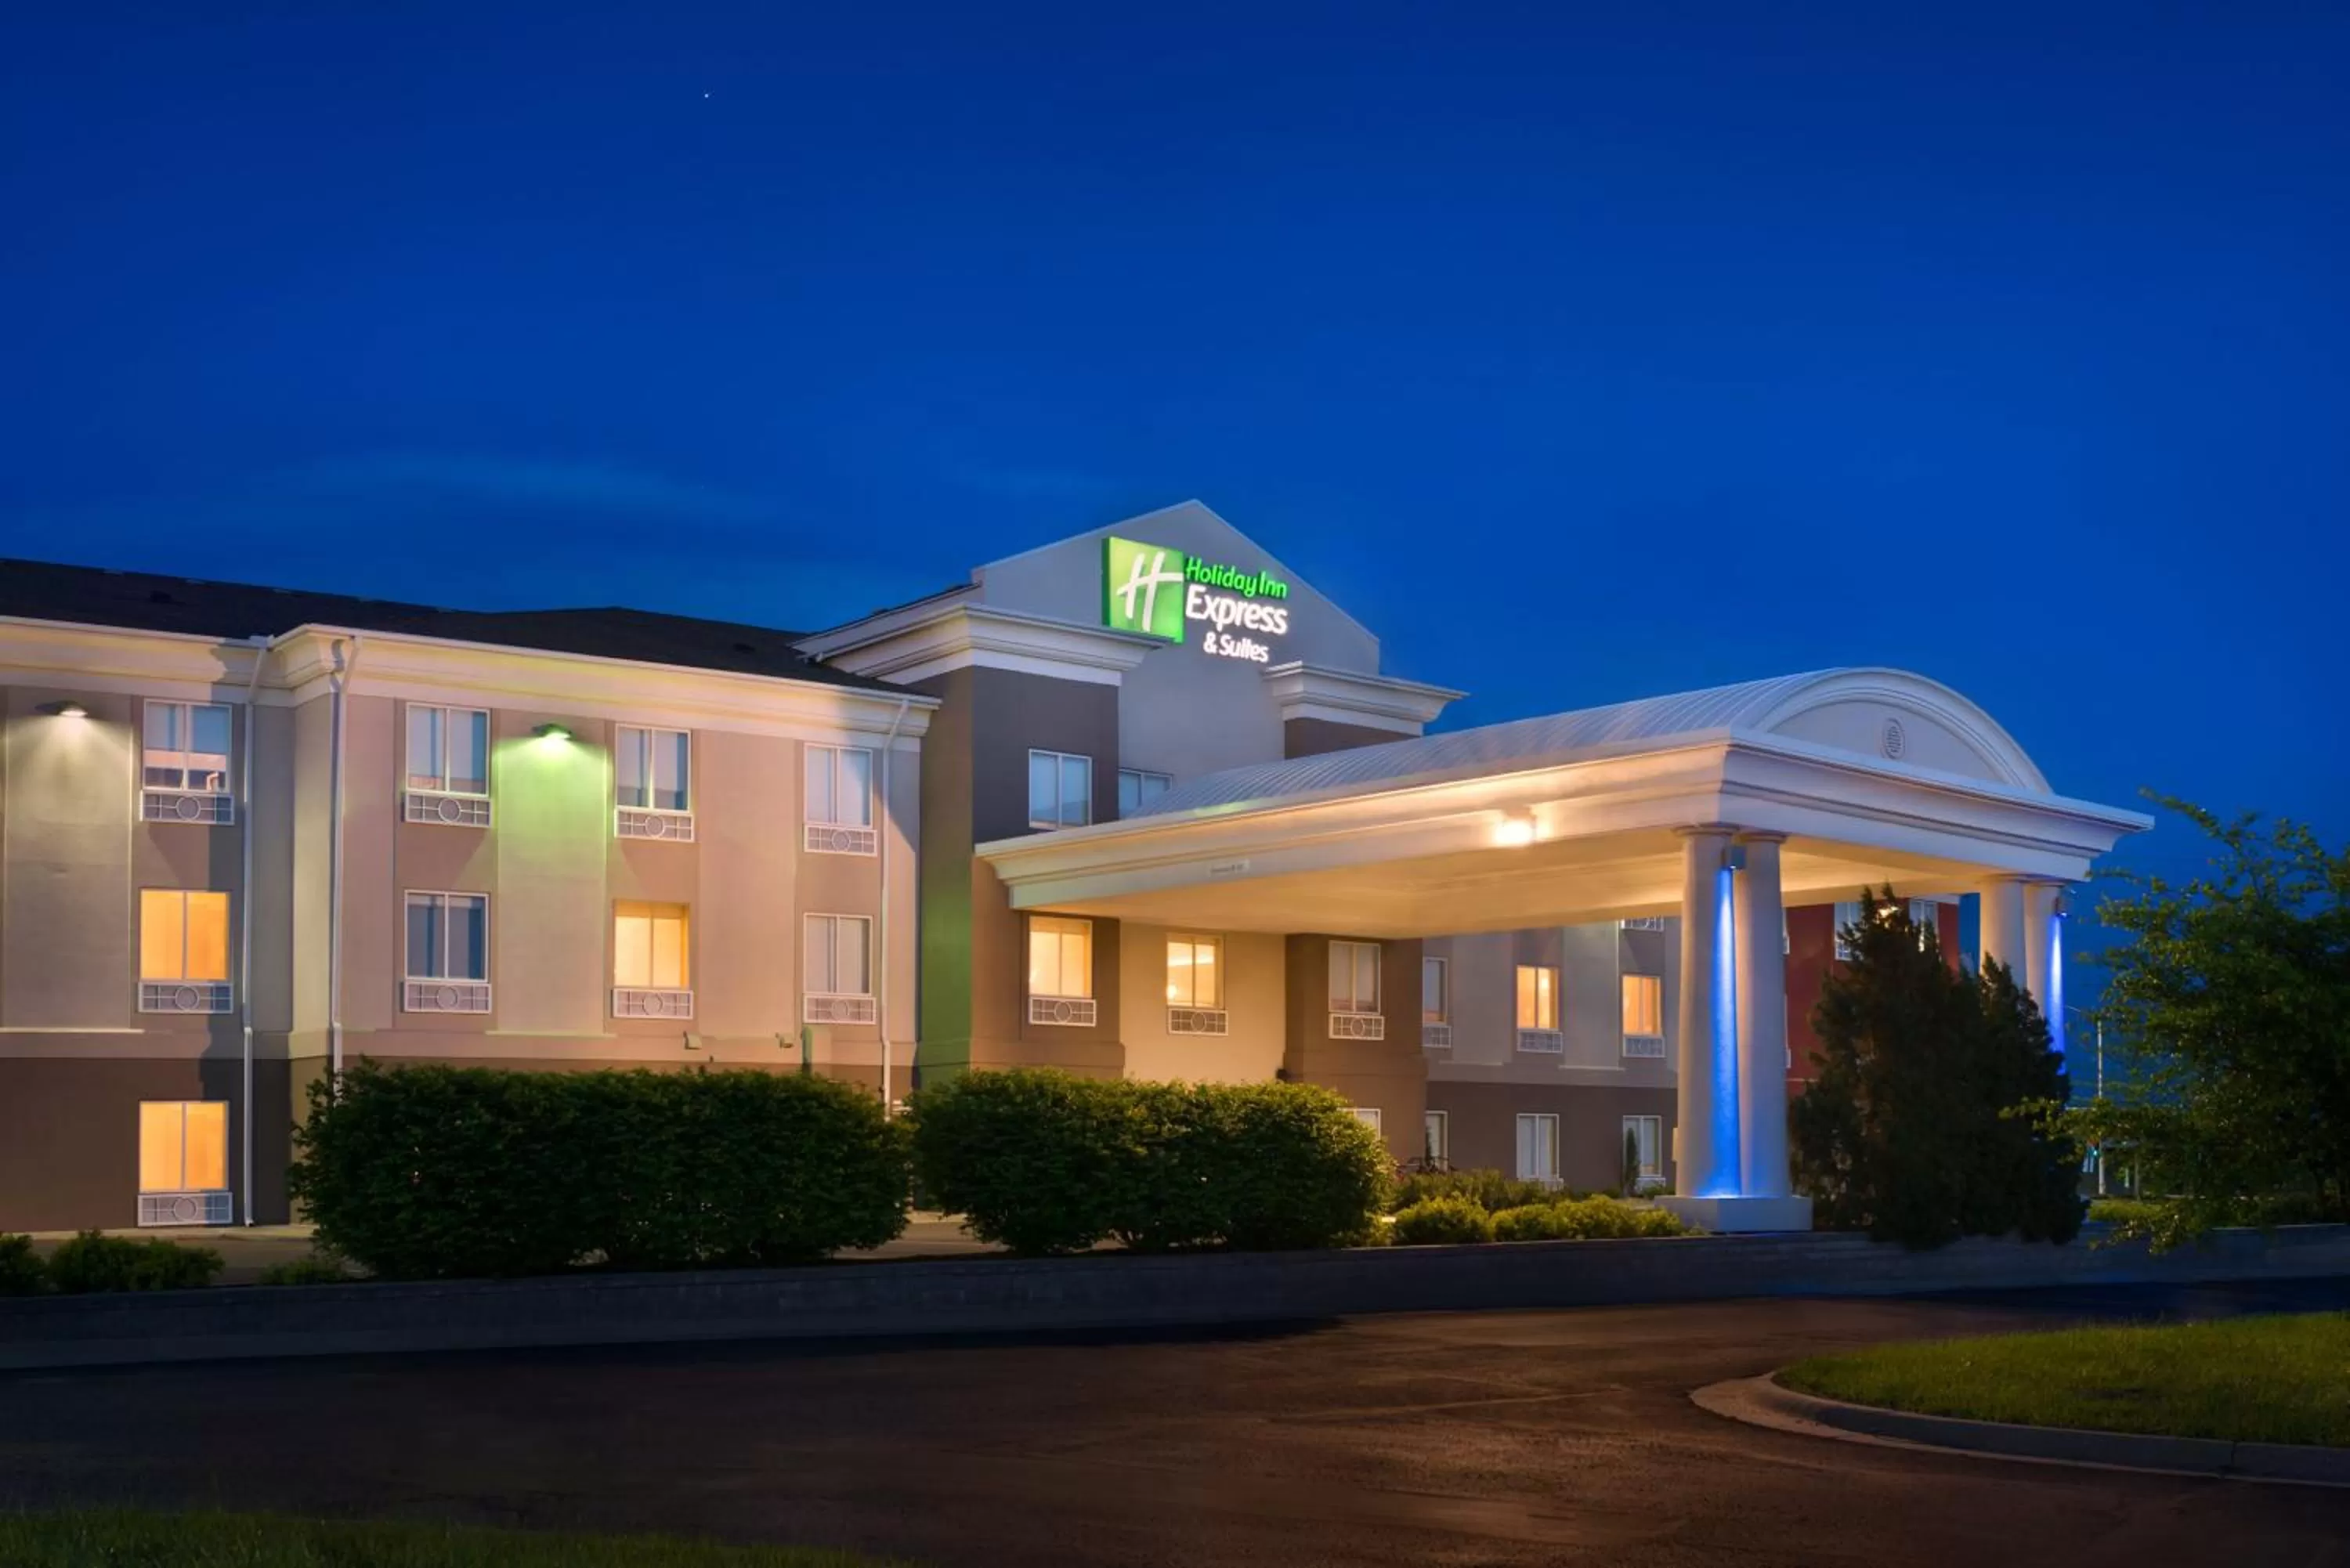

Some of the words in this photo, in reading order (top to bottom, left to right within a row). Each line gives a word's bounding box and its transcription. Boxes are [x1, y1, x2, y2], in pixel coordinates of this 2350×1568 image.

[1187, 557, 1256, 598] Holiday
[1259, 570, 1286, 598] Inn
[1185, 583, 1288, 634] Express
[1203, 632, 1217, 654] &
[1219, 634, 1269, 663] Suites
